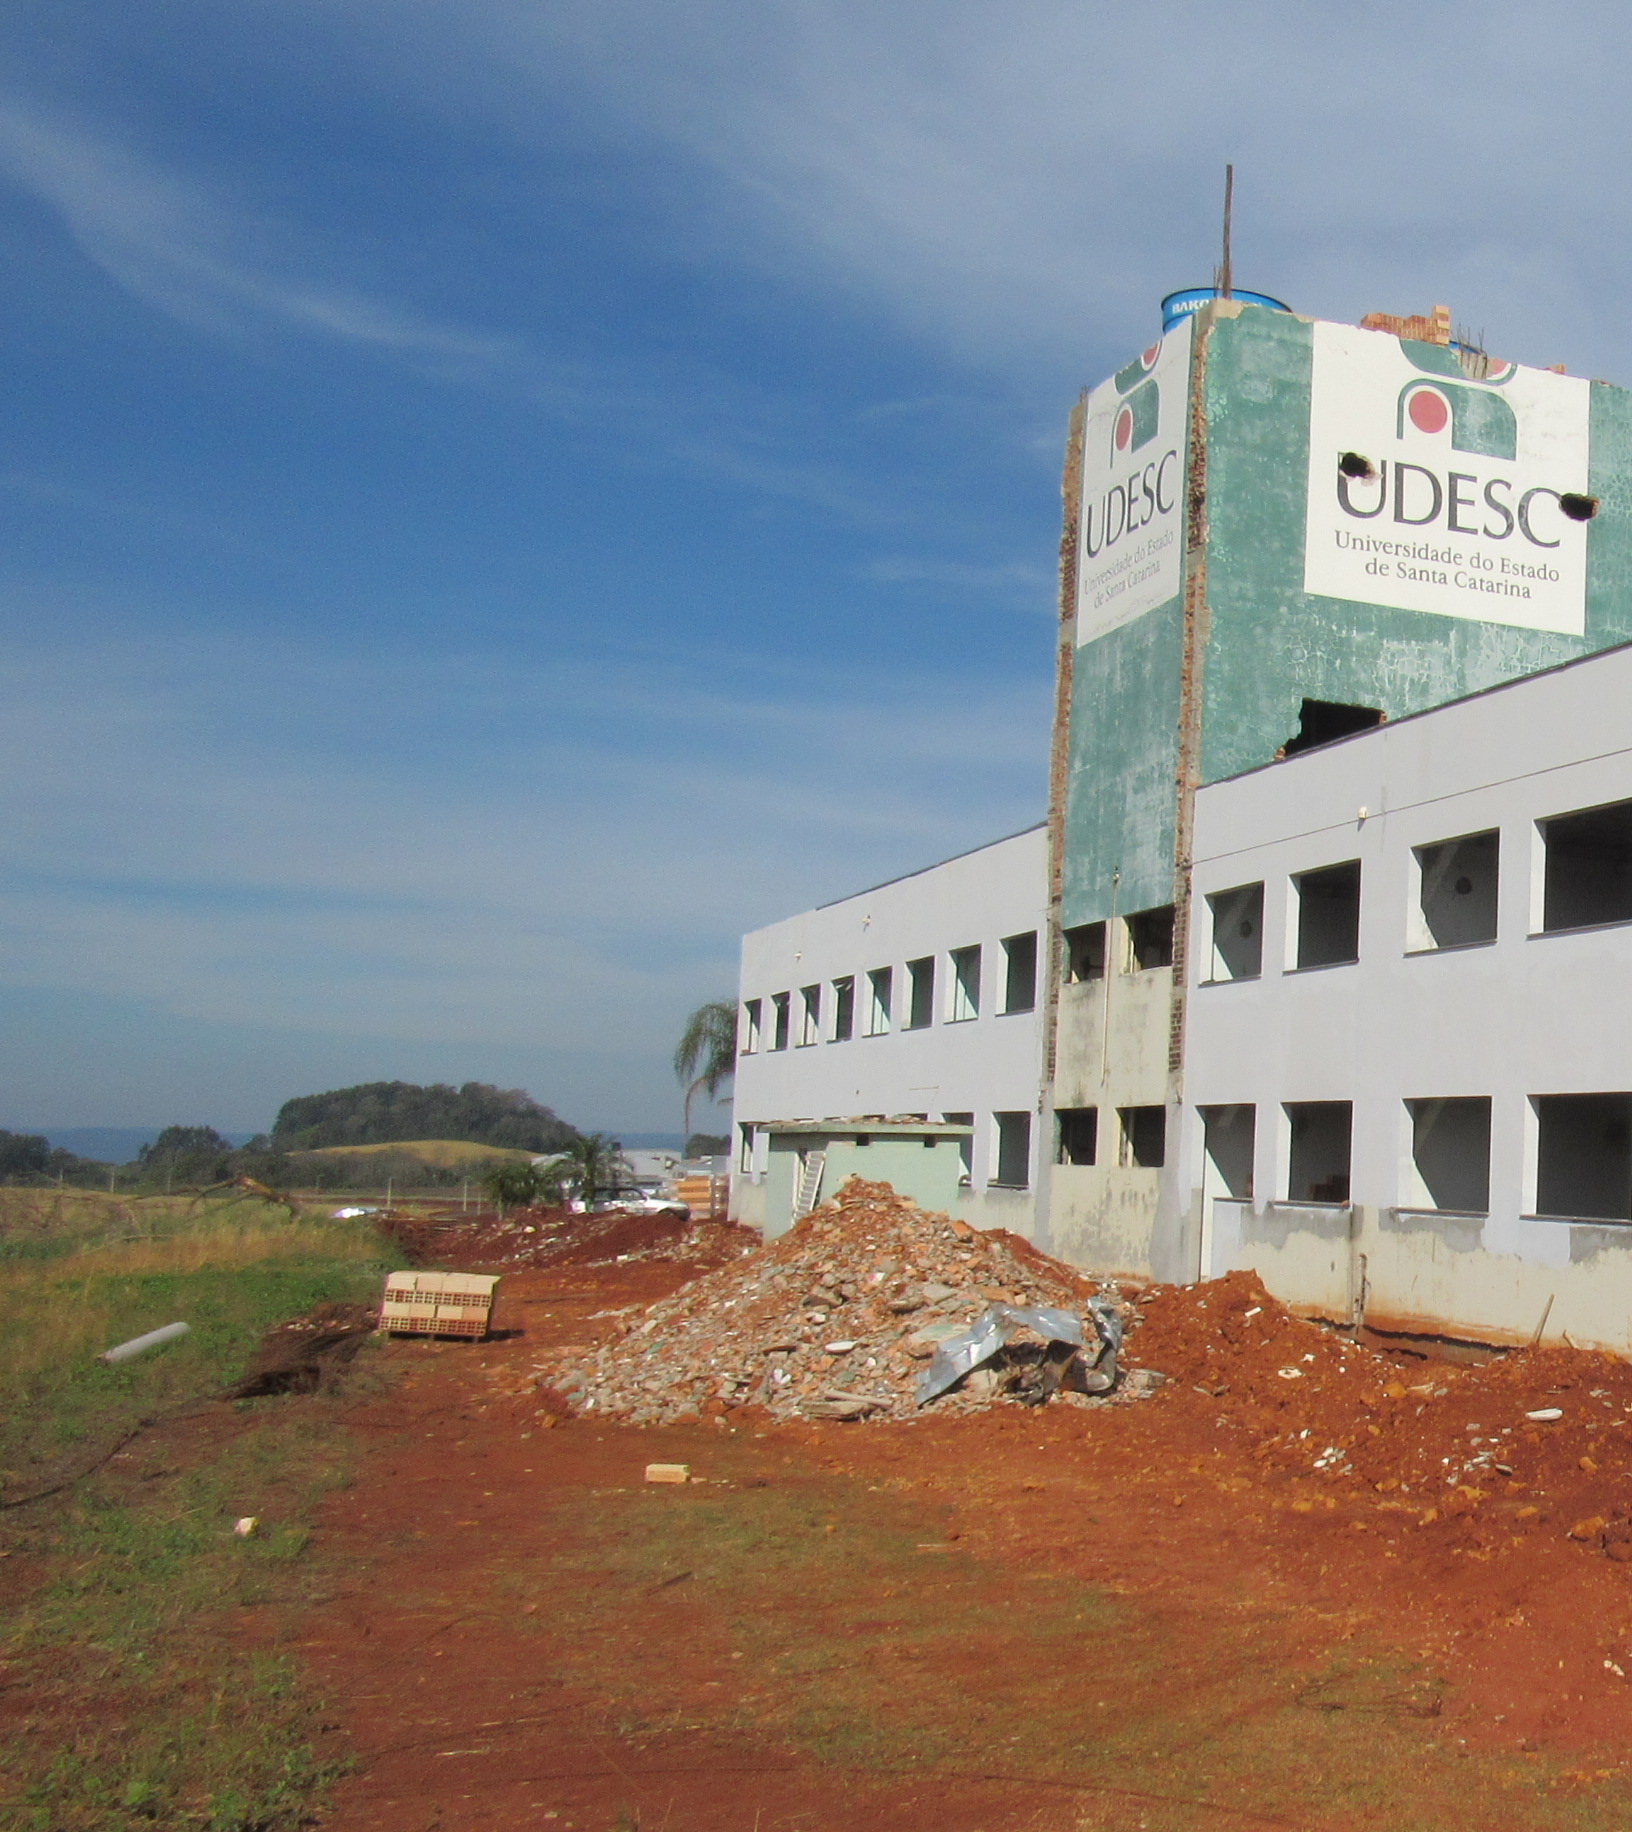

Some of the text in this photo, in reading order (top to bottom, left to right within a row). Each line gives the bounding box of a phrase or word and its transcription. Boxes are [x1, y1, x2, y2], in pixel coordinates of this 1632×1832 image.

[1087, 450, 1177, 558] UDESC
[1337, 451, 1561, 548] UDESC
[1084, 529, 1174, 596] Universidade do Estado
[1094, 559, 1161, 609] de Santa Catarina
[1335, 530, 1560, 582] Universidade do Estado
[1365, 558, 1532, 599] de Santa Catarina
